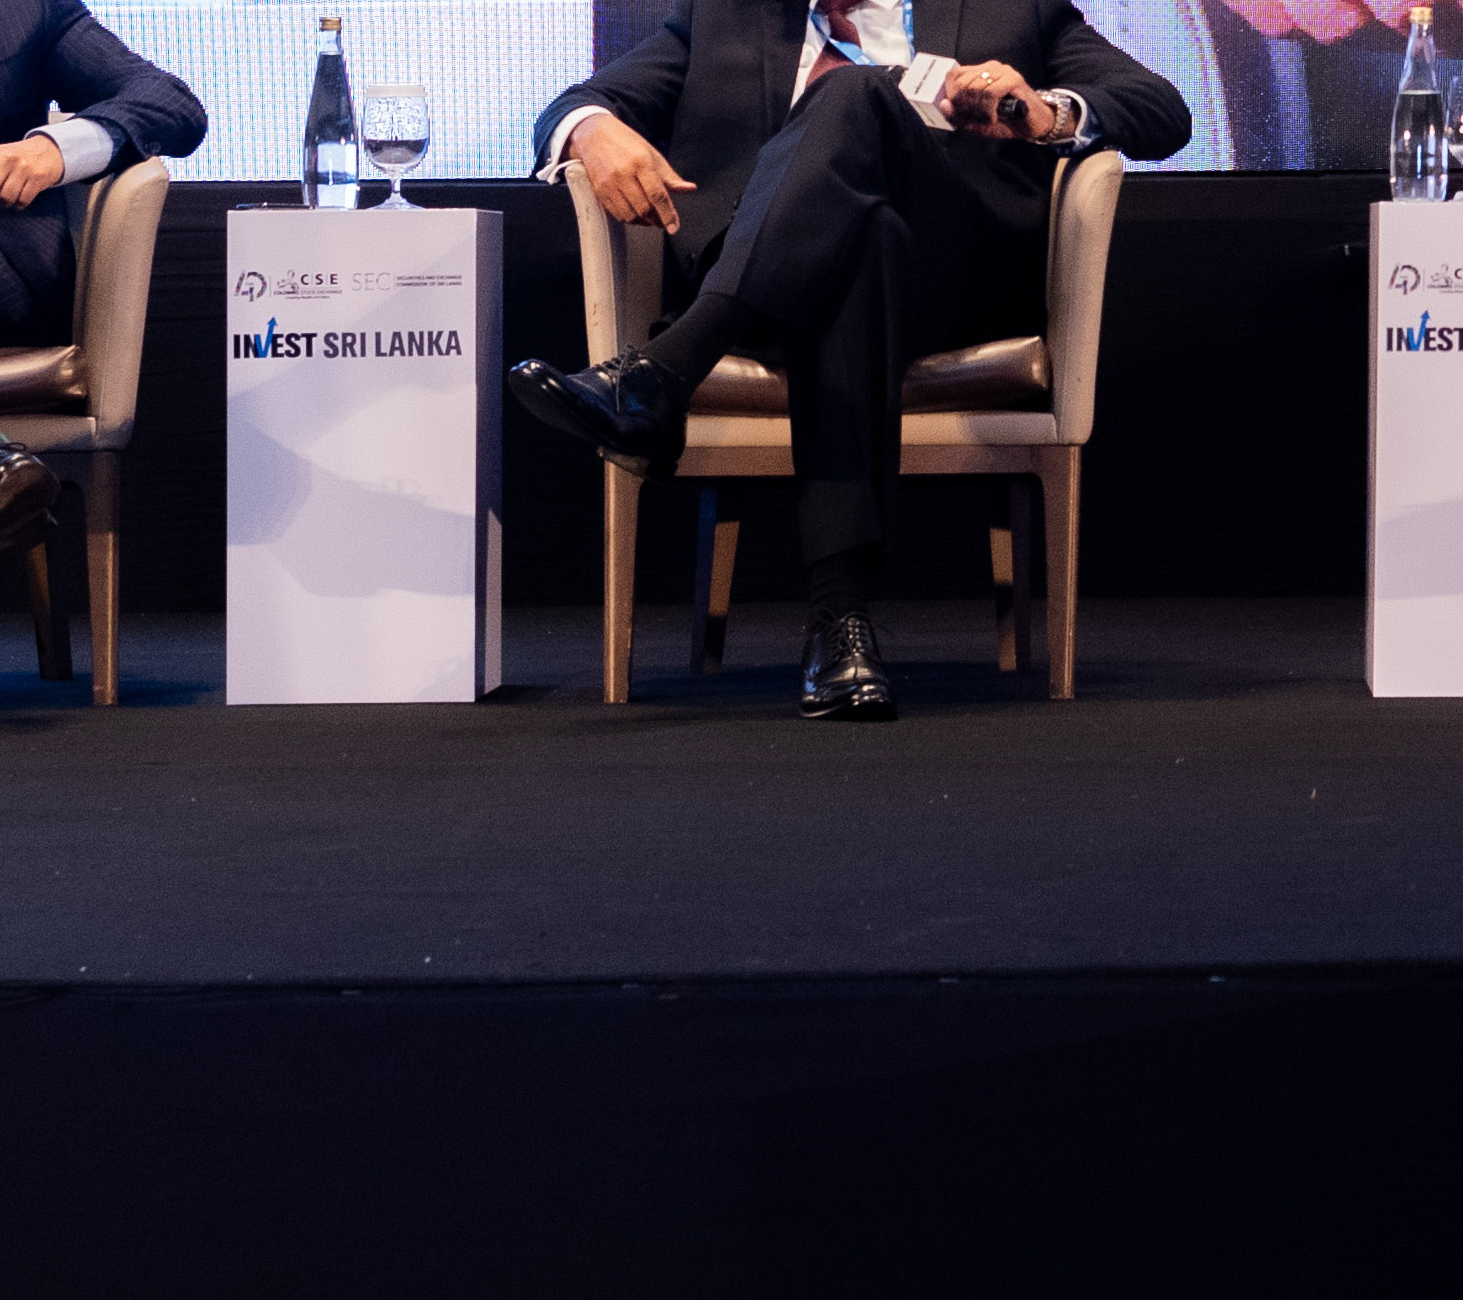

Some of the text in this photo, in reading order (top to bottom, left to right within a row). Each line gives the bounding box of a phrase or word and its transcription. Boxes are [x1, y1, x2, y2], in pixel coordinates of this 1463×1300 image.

[352, 272, 391, 291] SEC
[233, 316, 462, 359] INVEST SRI LANKA
